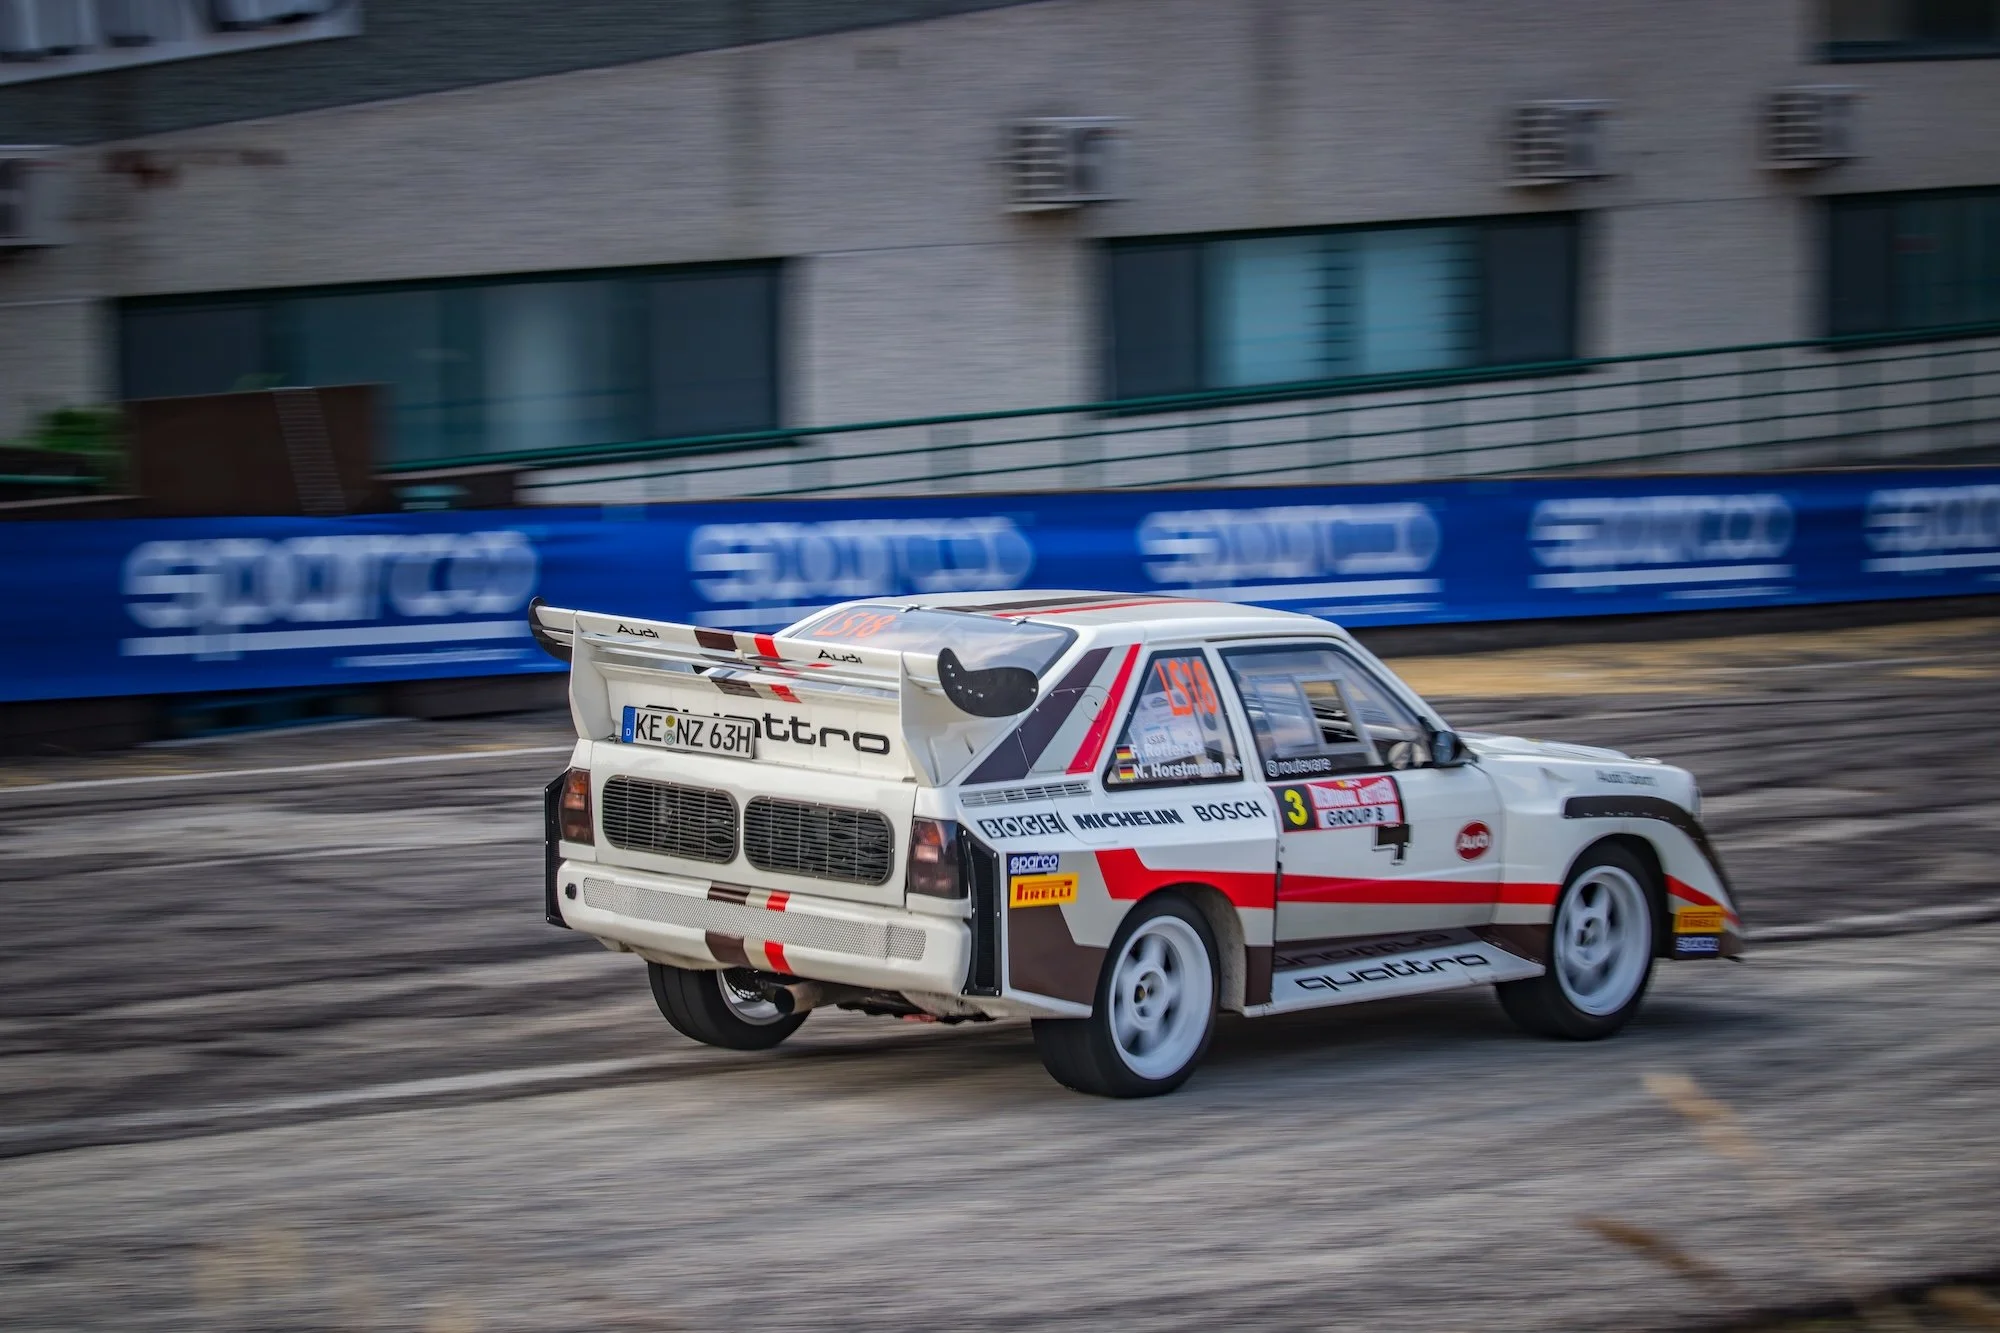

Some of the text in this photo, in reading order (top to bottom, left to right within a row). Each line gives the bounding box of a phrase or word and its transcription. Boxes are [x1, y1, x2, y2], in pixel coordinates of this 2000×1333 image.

[617, 623, 660, 639] Audi
[818, 649, 864, 664] Audi
[1154, 660, 1218, 716] LS18
[625, 729, 631, 737] D
[635, 712, 751, 753] KE NZ 63H
[1133, 763, 1149, 779] N.
[1151, 760, 1223, 778] Horstmann
[1192, 800, 1267, 822] BOSCH
[1284, 789, 1309, 826] 3
[1327, 808, 1373, 826] GROUP
[1073, 809, 1184, 830] MICHELIN
[1010, 854, 1058, 875] sparco
[1016, 880, 1072, 901] PIRELLI
[1294, 953, 1490, 992] quattro
